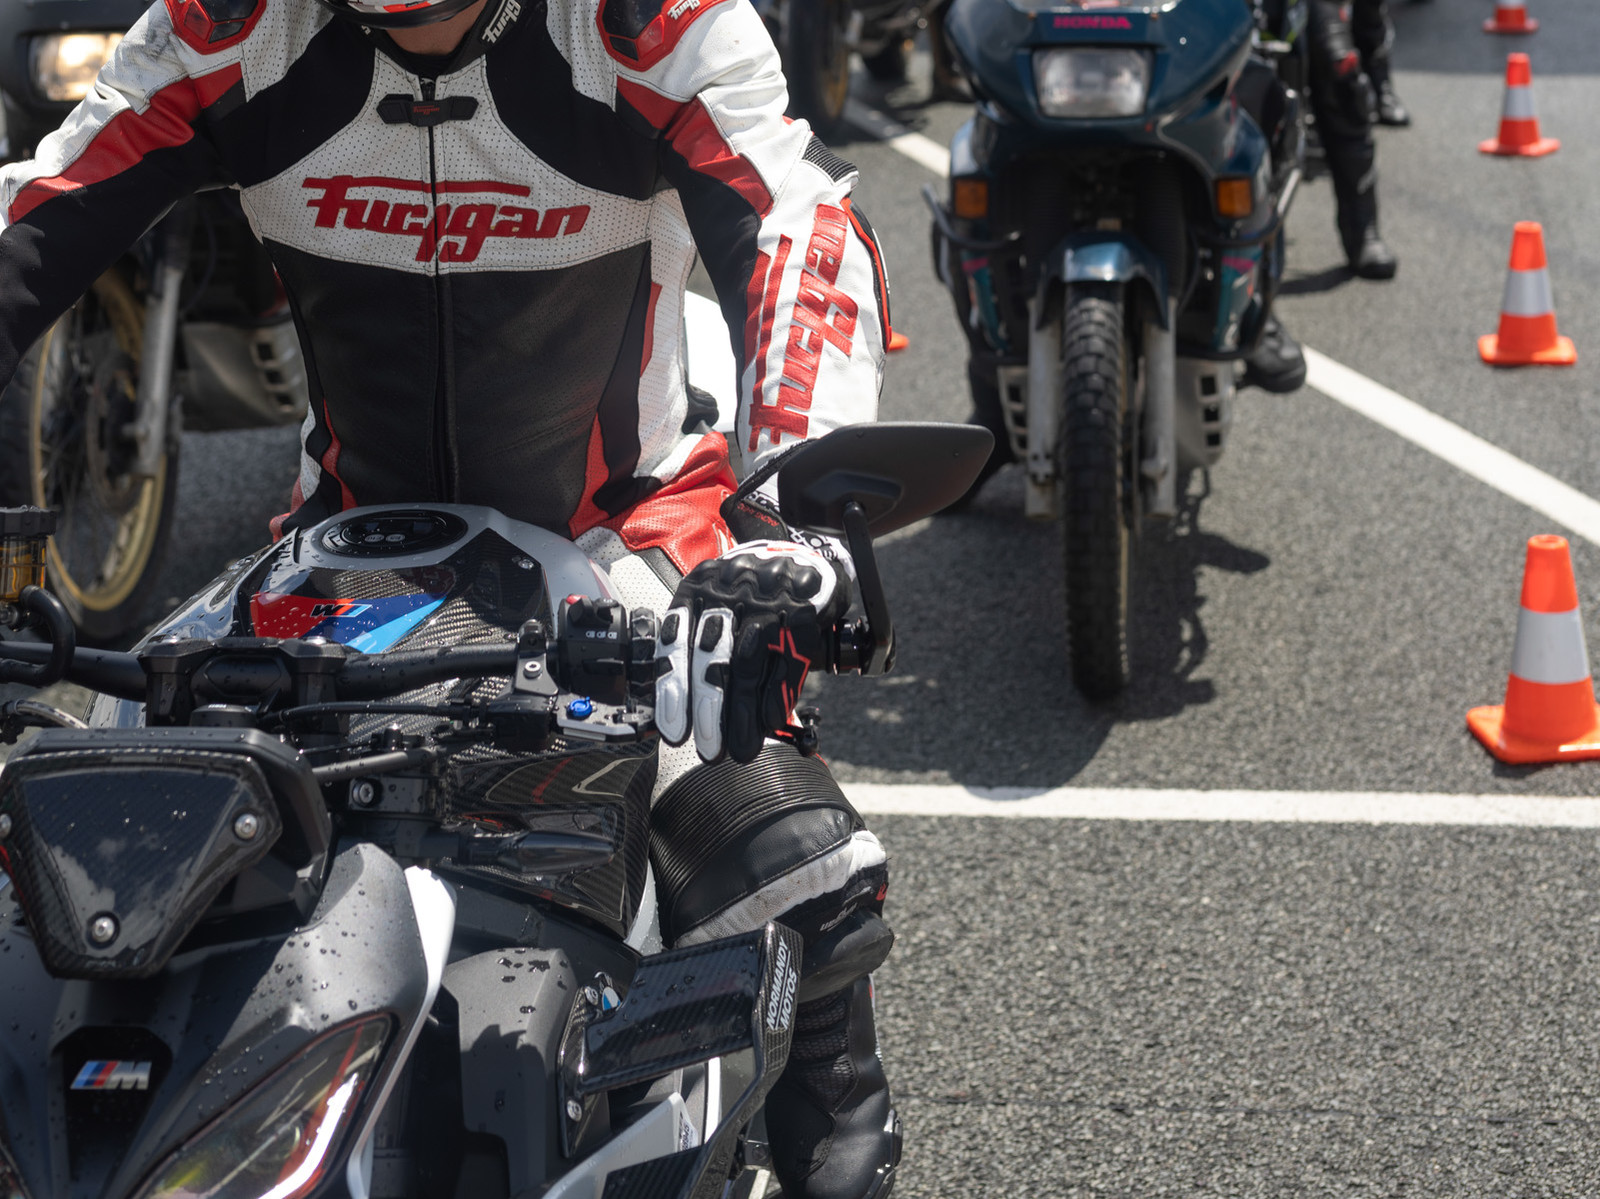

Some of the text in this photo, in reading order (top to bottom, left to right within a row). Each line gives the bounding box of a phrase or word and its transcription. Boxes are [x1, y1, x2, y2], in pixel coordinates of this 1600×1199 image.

[1053, 16, 1132, 29] HONDA
[767, 935, 788, 1030] NORMANDY
[780, 967, 797, 1030] MOTOS
